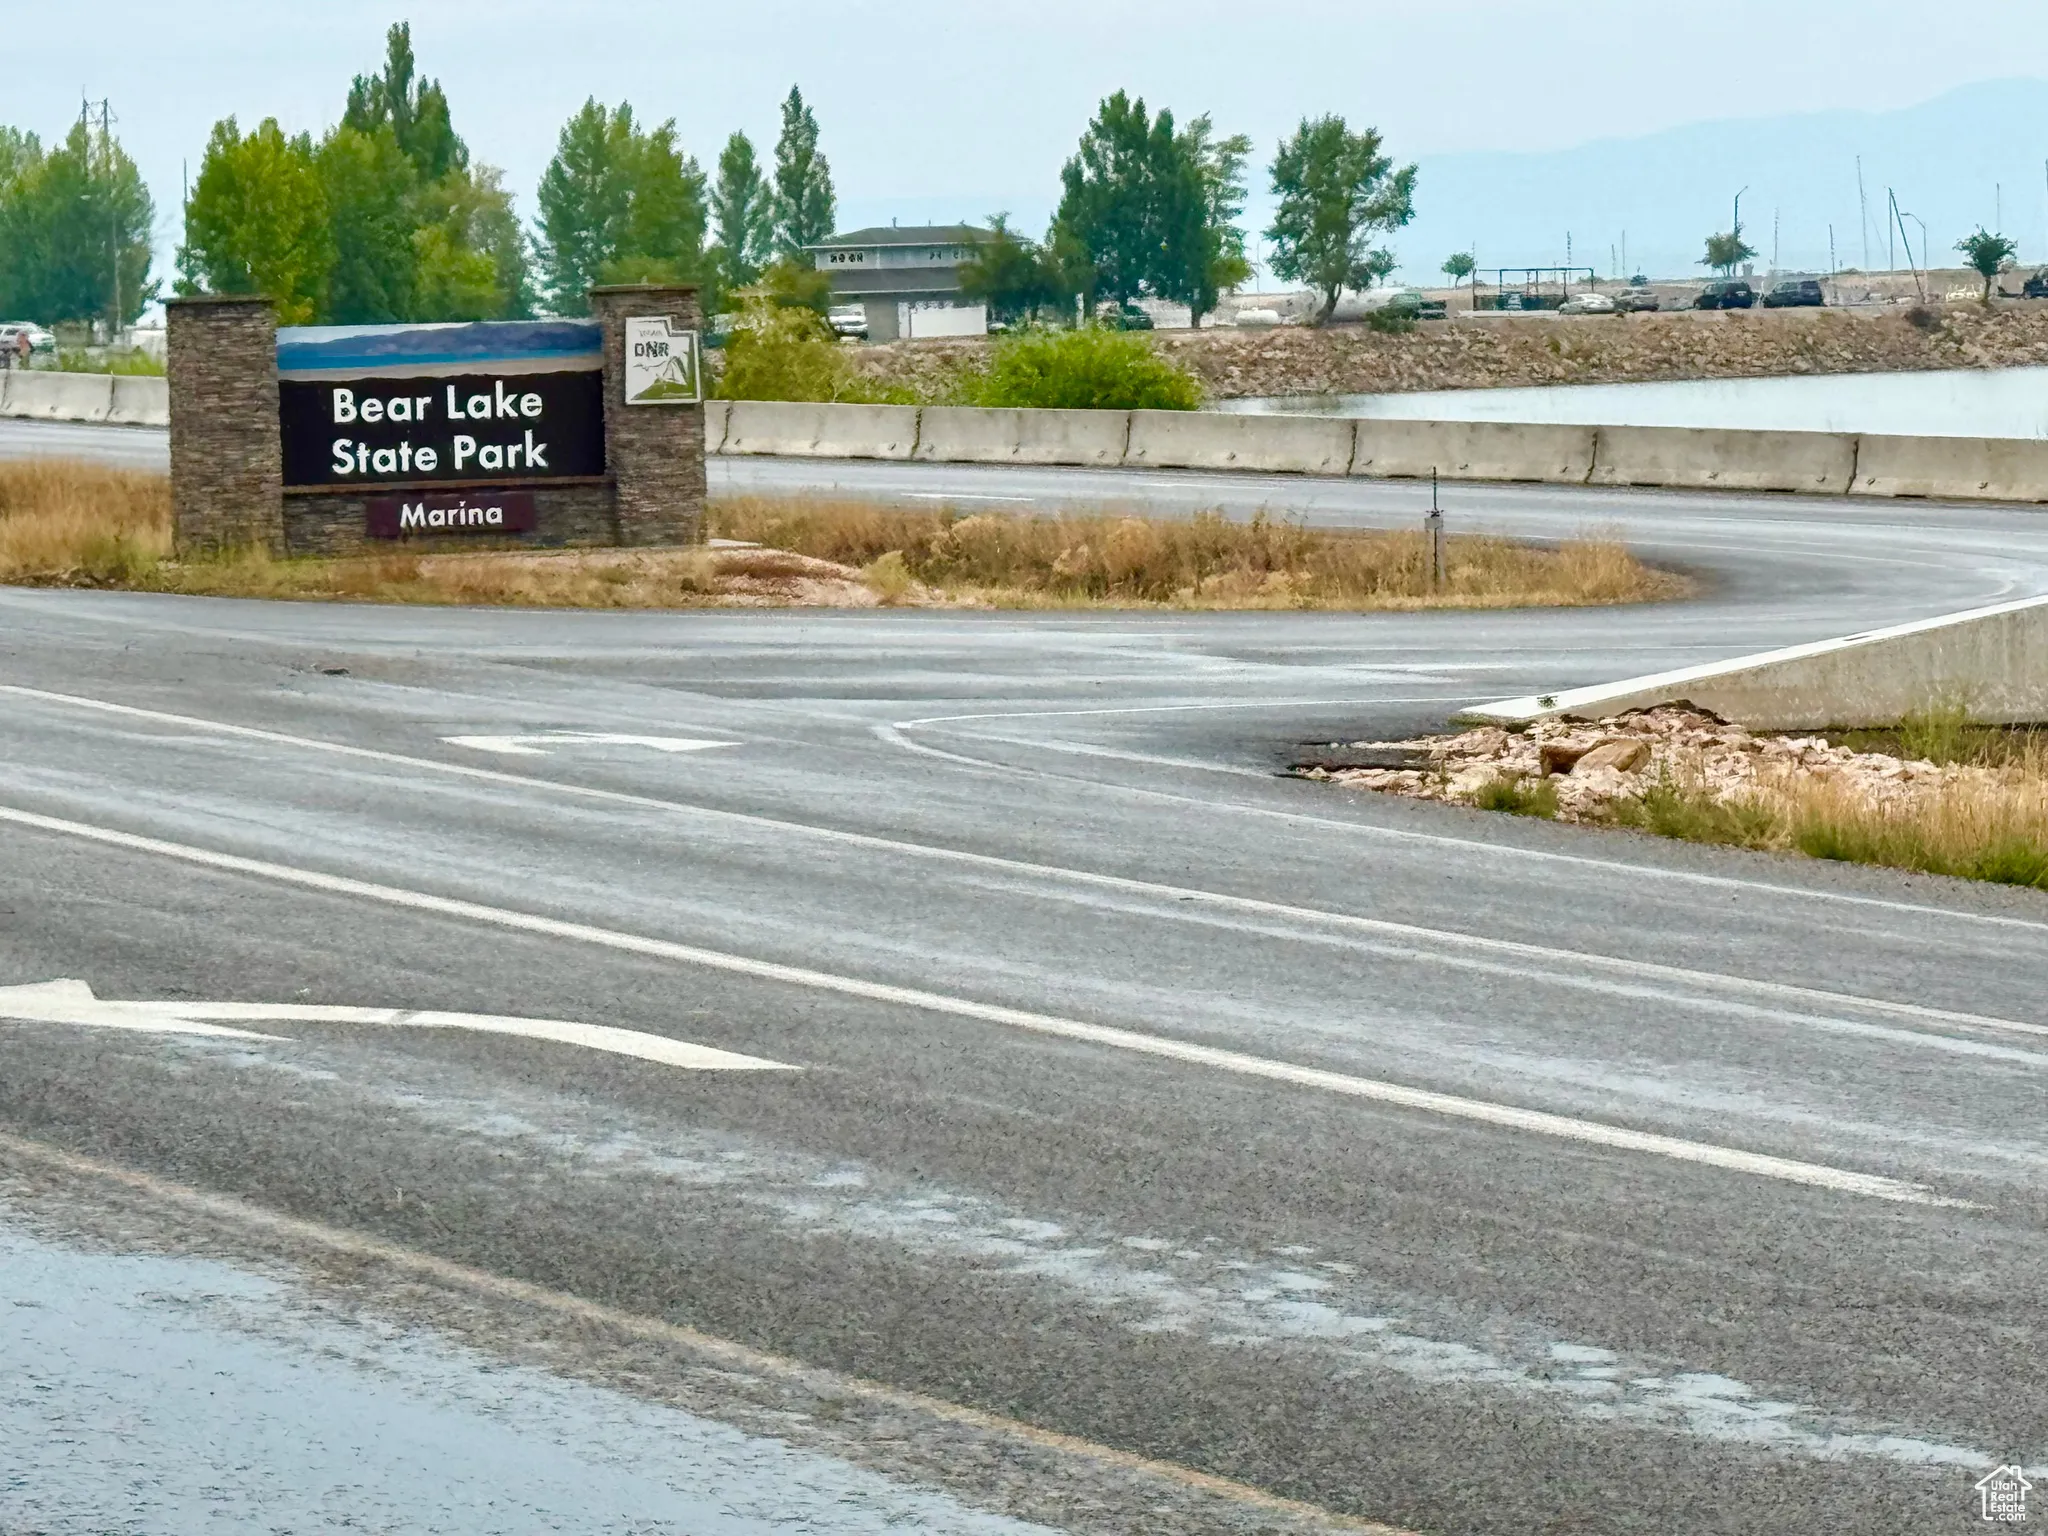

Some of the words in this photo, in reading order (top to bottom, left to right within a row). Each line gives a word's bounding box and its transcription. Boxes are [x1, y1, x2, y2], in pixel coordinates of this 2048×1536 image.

[634, 341, 669, 358] DNR
[333, 388, 432, 424] Bear
[446, 380, 543, 420] Lake
[332, 438, 438, 475] State
[453, 429, 549, 470] Park
[399, 500, 503, 529] Marina
